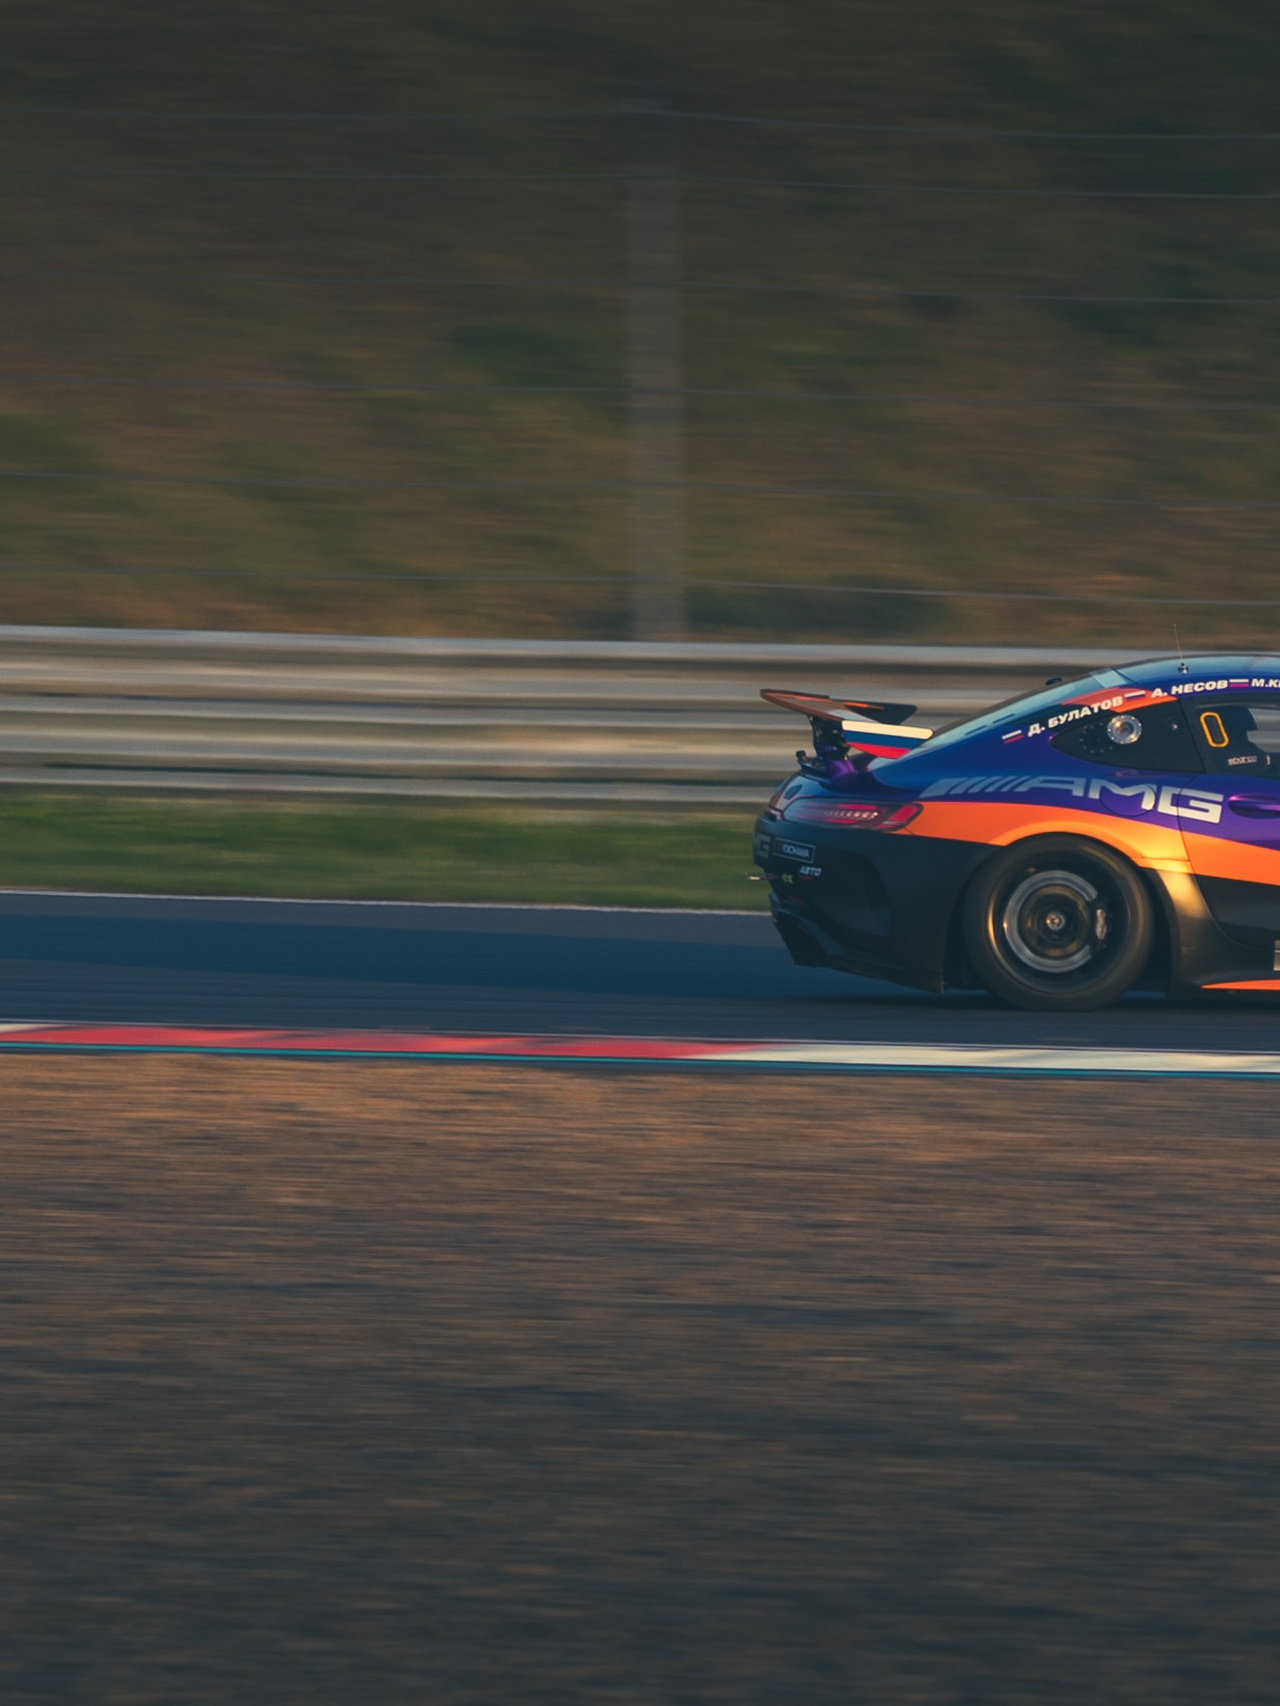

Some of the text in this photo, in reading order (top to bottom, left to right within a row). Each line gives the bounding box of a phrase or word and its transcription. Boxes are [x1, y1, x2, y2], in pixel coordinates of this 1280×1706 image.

[1171, 680, 1228, 695] НЕСОВ
[1027, 696, 1123, 737] Д. БУЛАТОВ
[1014, 776, 1224, 823] AMG
